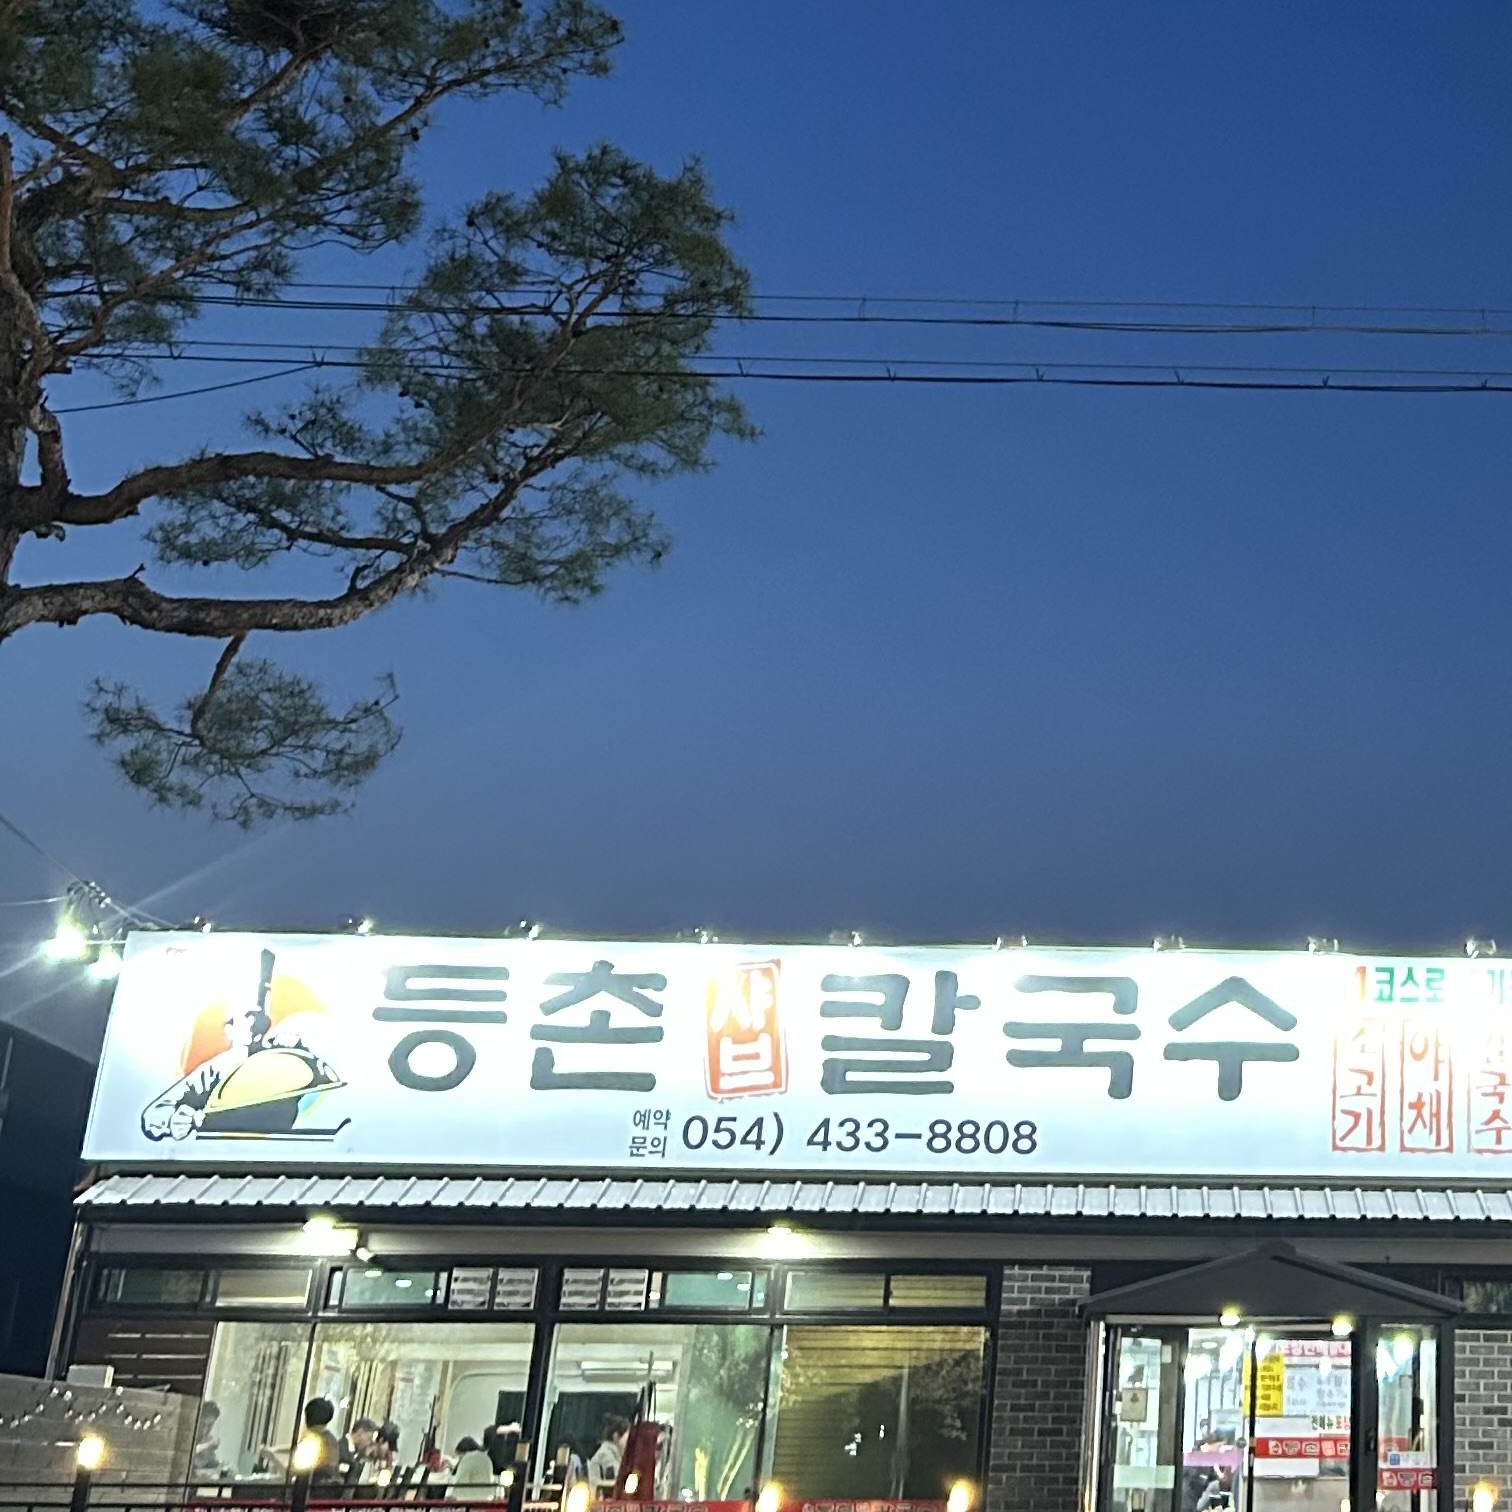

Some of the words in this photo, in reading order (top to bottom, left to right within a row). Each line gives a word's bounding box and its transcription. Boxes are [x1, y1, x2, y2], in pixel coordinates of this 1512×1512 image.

[1355, 966, 1445, 1002] 1코스로
[372, 960, 667, 1092] 등촌
[819, 970, 1300, 1100] 칼국수
[1407, 1029, 1446, 1148] 야채
[1474, 1031, 1512, 1146] 국수
[632, 1108, 672, 1131] 예약
[682, 1112, 784, 1156] 054)
[806, 1117, 1038, 1155] 433-8808
[628, 1134, 668, 1159] 문의
